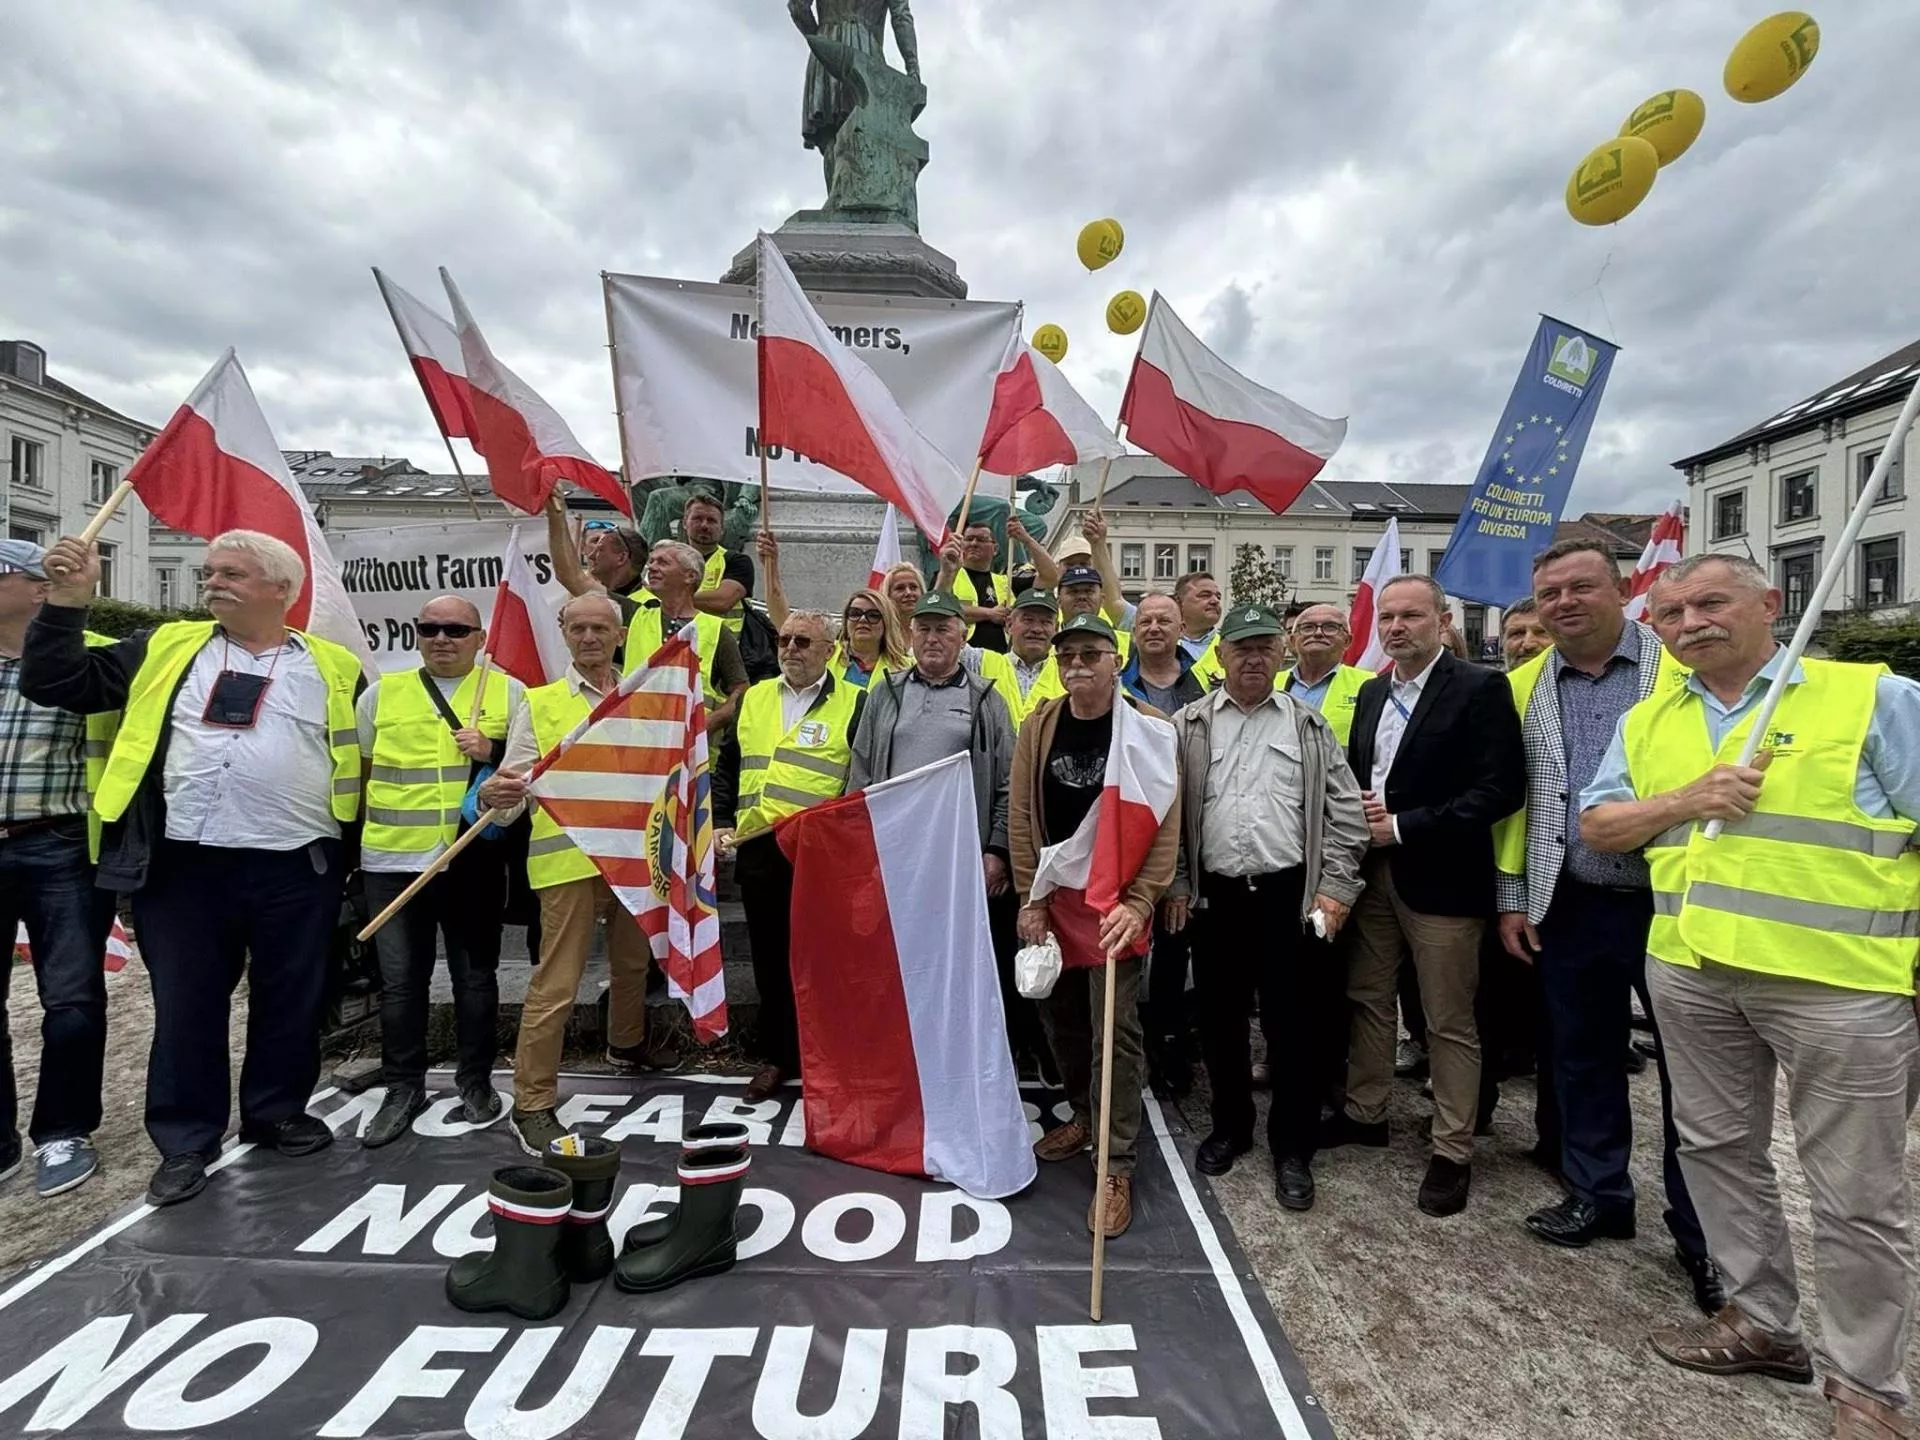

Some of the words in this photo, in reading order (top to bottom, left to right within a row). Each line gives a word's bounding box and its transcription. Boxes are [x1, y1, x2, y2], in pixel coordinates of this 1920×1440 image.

[828, 325, 910, 355] mers,
[1471, 497, 1490, 515] PER
[1489, 503, 1553, 526] UN'EUROPA
[1485, 483, 1545, 508] COLDIRETTI
[1478, 519, 1527, 539] DIVERSA
[341, 555, 431, 593] Without
[436, 553, 552, 590] Farms
[649, 811, 672, 897] SAMOOBR
[606, 1183, 1013, 1263] FOOD
[0, 1313, 319, 1431] NO
[315, 1323, 1165, 1440] FUTURE
